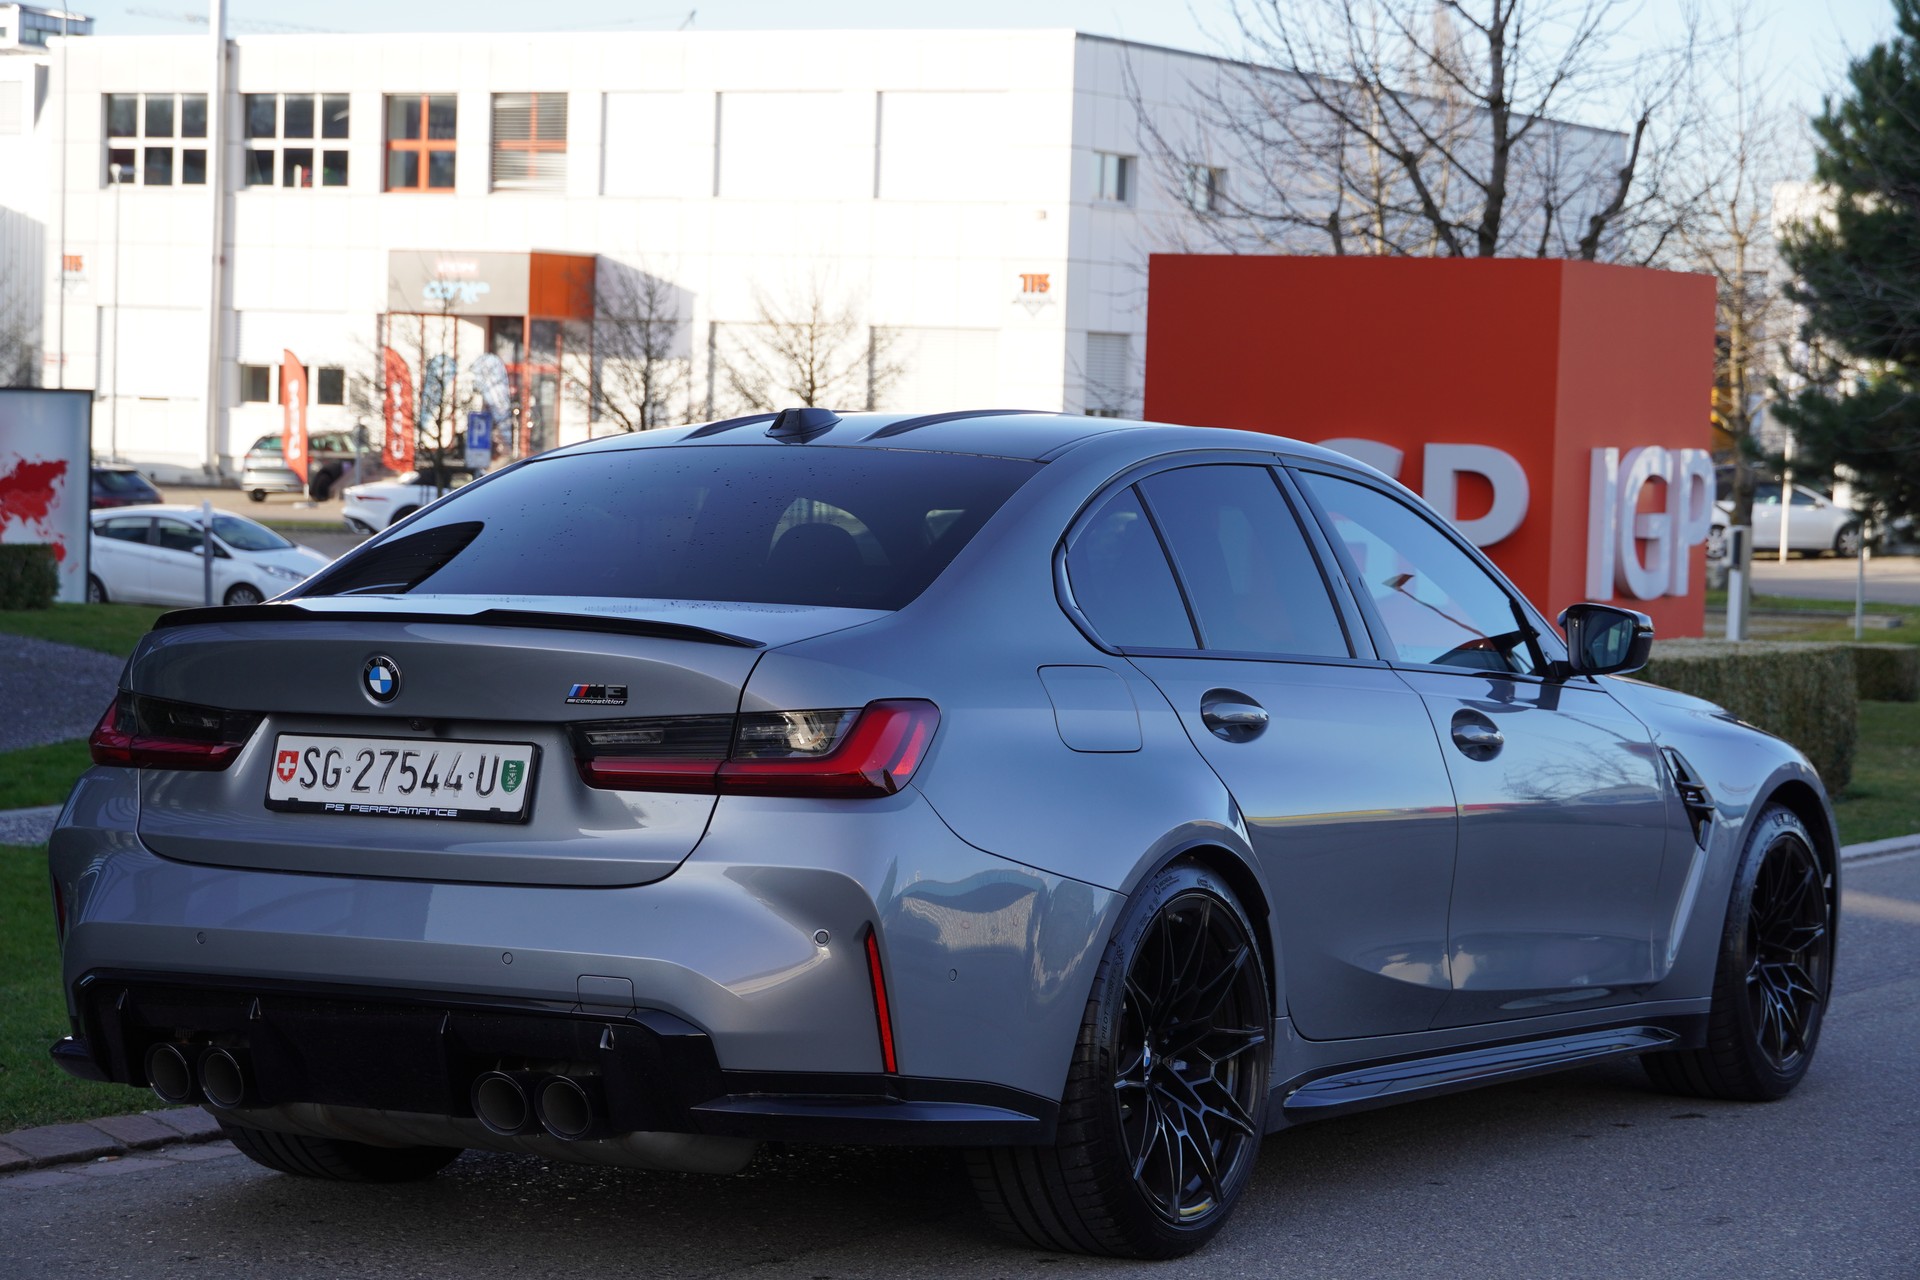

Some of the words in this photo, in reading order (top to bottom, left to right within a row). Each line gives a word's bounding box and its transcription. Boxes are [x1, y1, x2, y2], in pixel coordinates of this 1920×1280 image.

[473, 416, 486, 446] P
[1587, 446, 1717, 600] IGP
[366, 658, 396, 673] BMW
[580, 684, 628, 698] M3
[325, 804, 345, 812] PS
[350, 804, 458, 817] PERFORMANCE
[1101, 1011, 1109, 1040] PILOT
